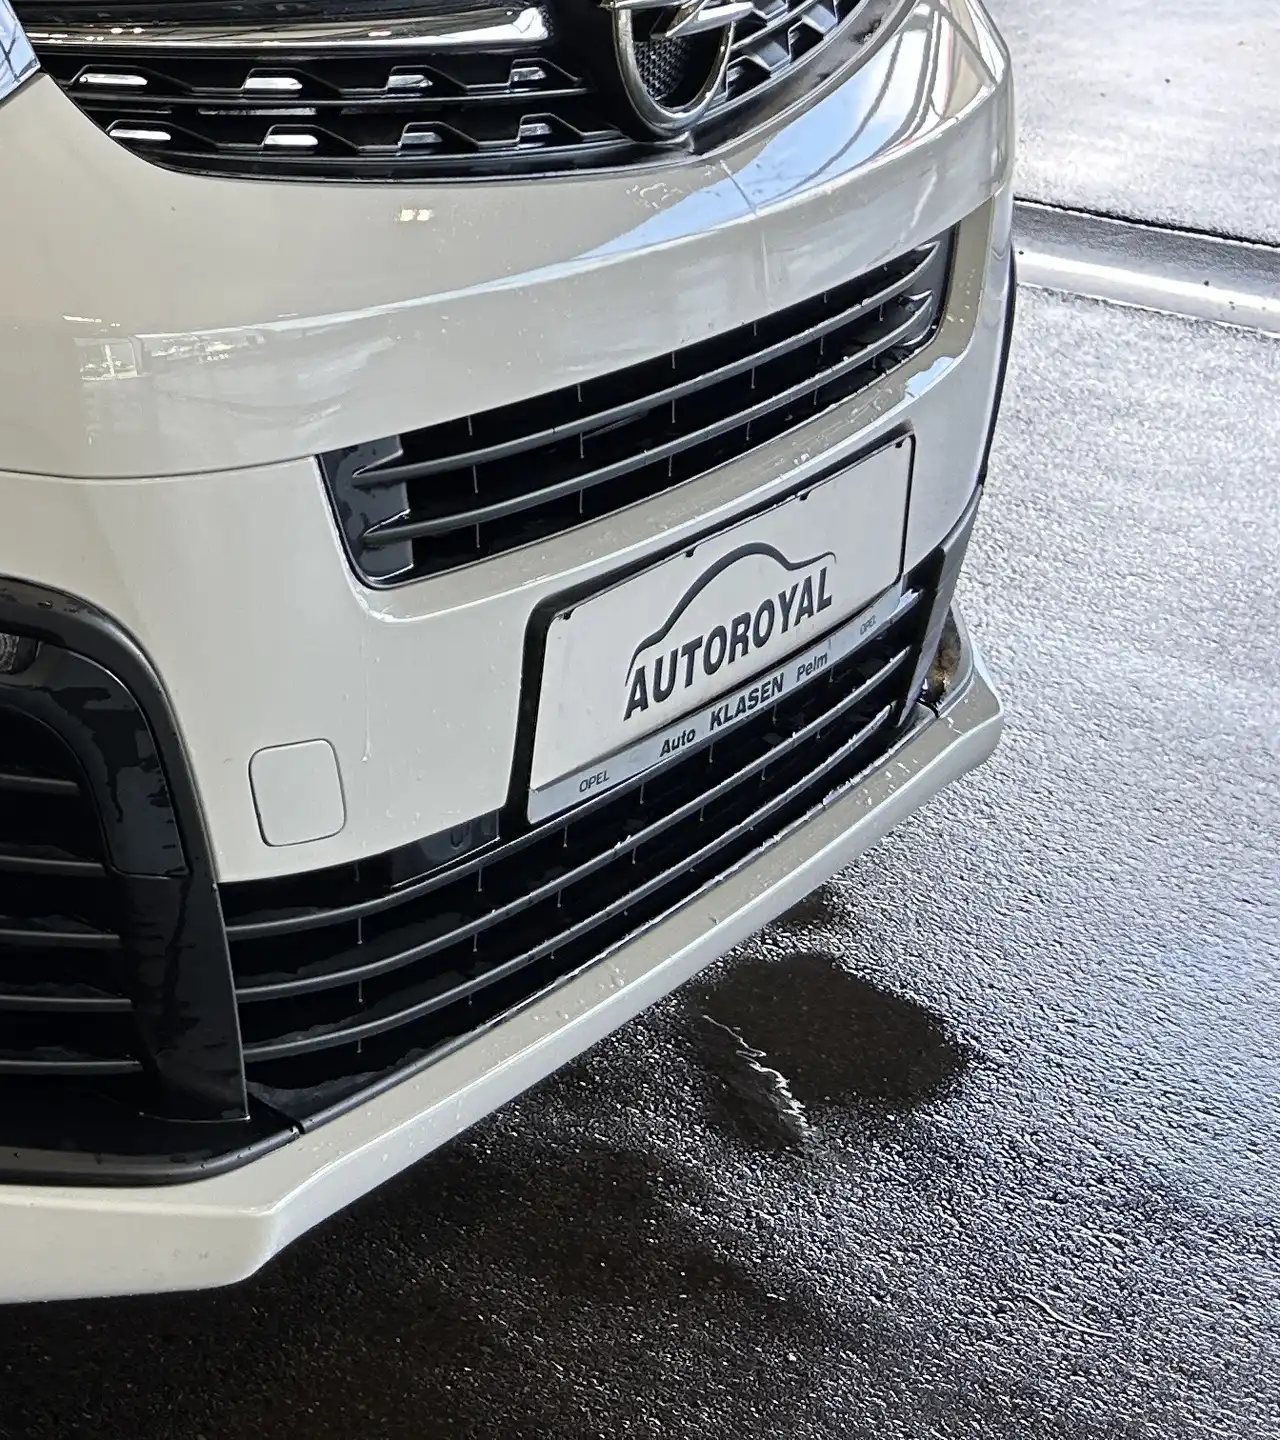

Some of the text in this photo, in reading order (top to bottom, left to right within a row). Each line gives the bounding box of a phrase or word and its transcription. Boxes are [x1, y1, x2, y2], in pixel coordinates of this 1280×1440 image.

[622, 566, 833, 721] AUTOROYAL
[578, 769, 611, 793] OPEL
[659, 728, 696, 758] Auto
[709, 672, 784, 731] KLASEN
[796, 652, 828, 683] Pelm
